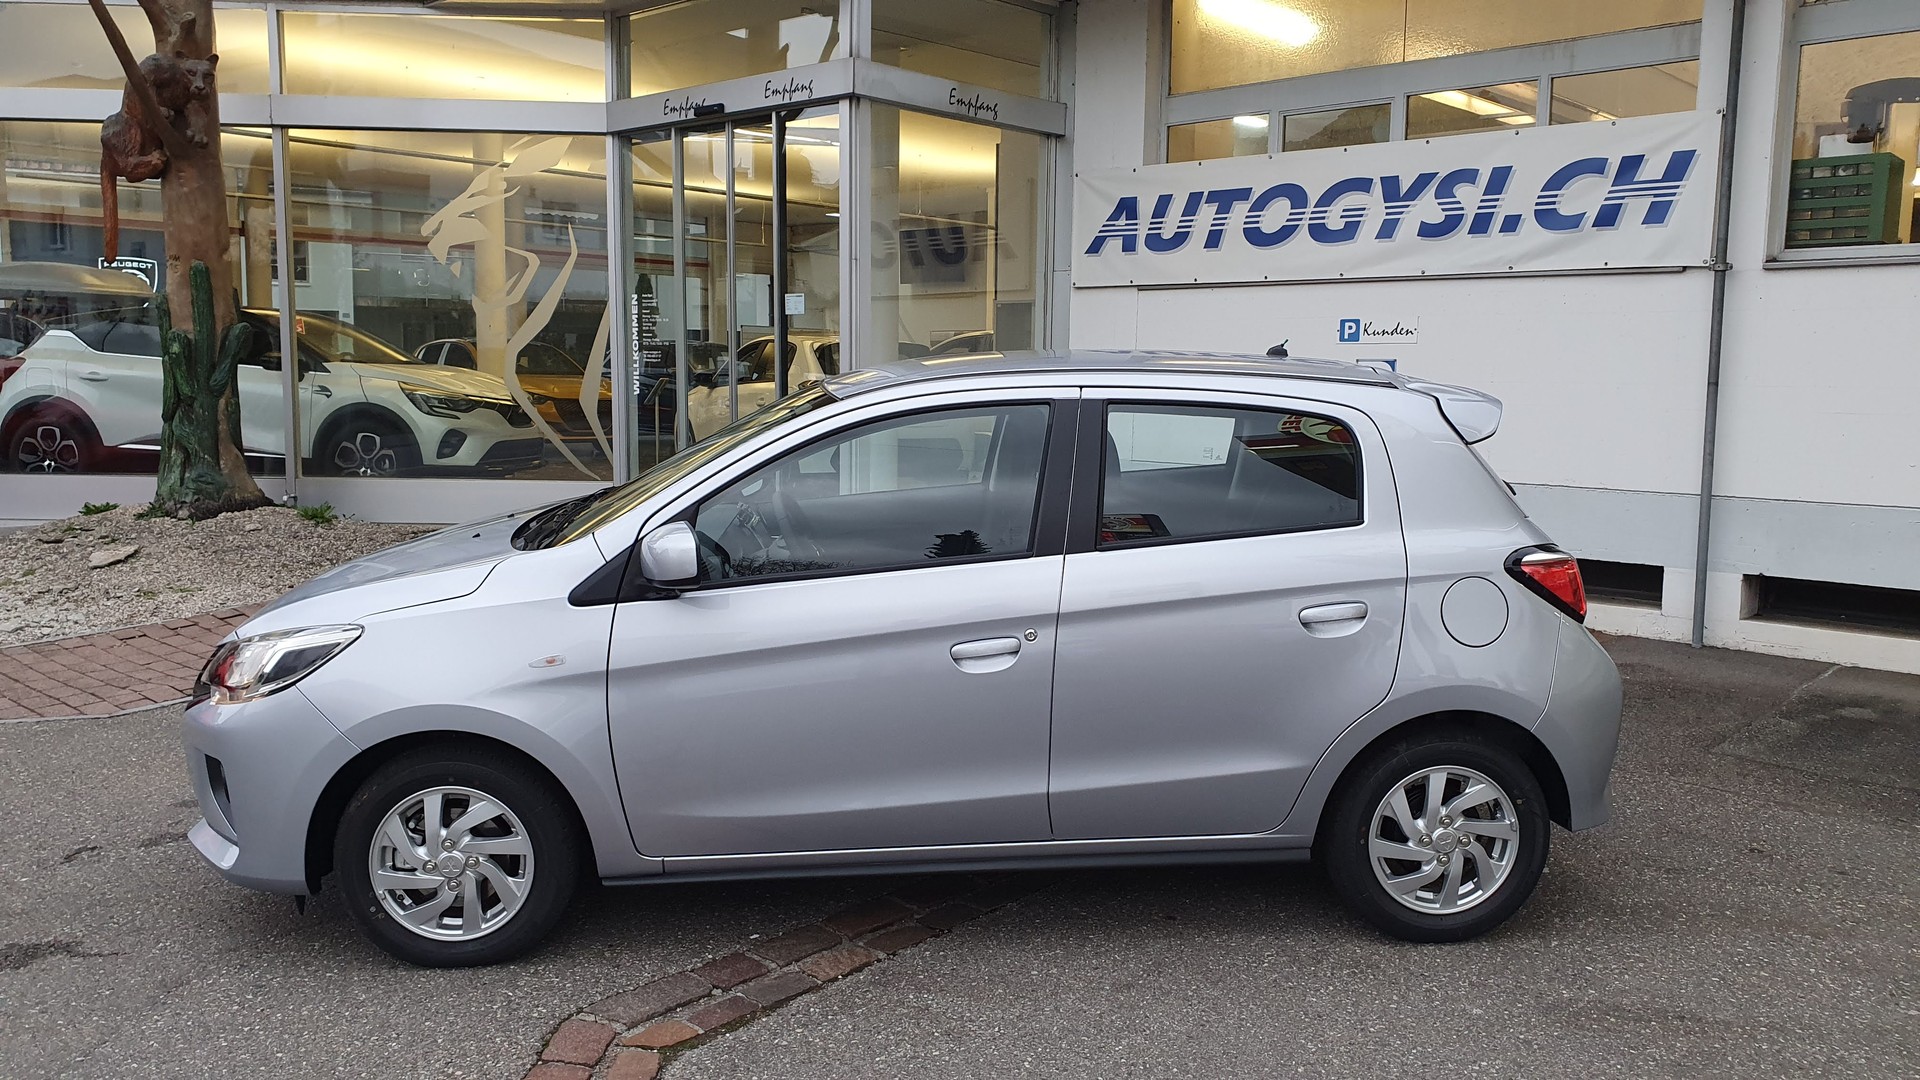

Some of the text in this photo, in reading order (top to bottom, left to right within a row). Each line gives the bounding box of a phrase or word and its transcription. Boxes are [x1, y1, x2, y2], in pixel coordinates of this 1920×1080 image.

[764, 77, 813, 101] Empfang
[949, 87, 998, 121] Empfang
[1084, 149, 1698, 256] AUTOGYSI.CH
[631, 294, 641, 396] WILLKOMMEN
[1344, 321, 1415, 339] P Kunden
